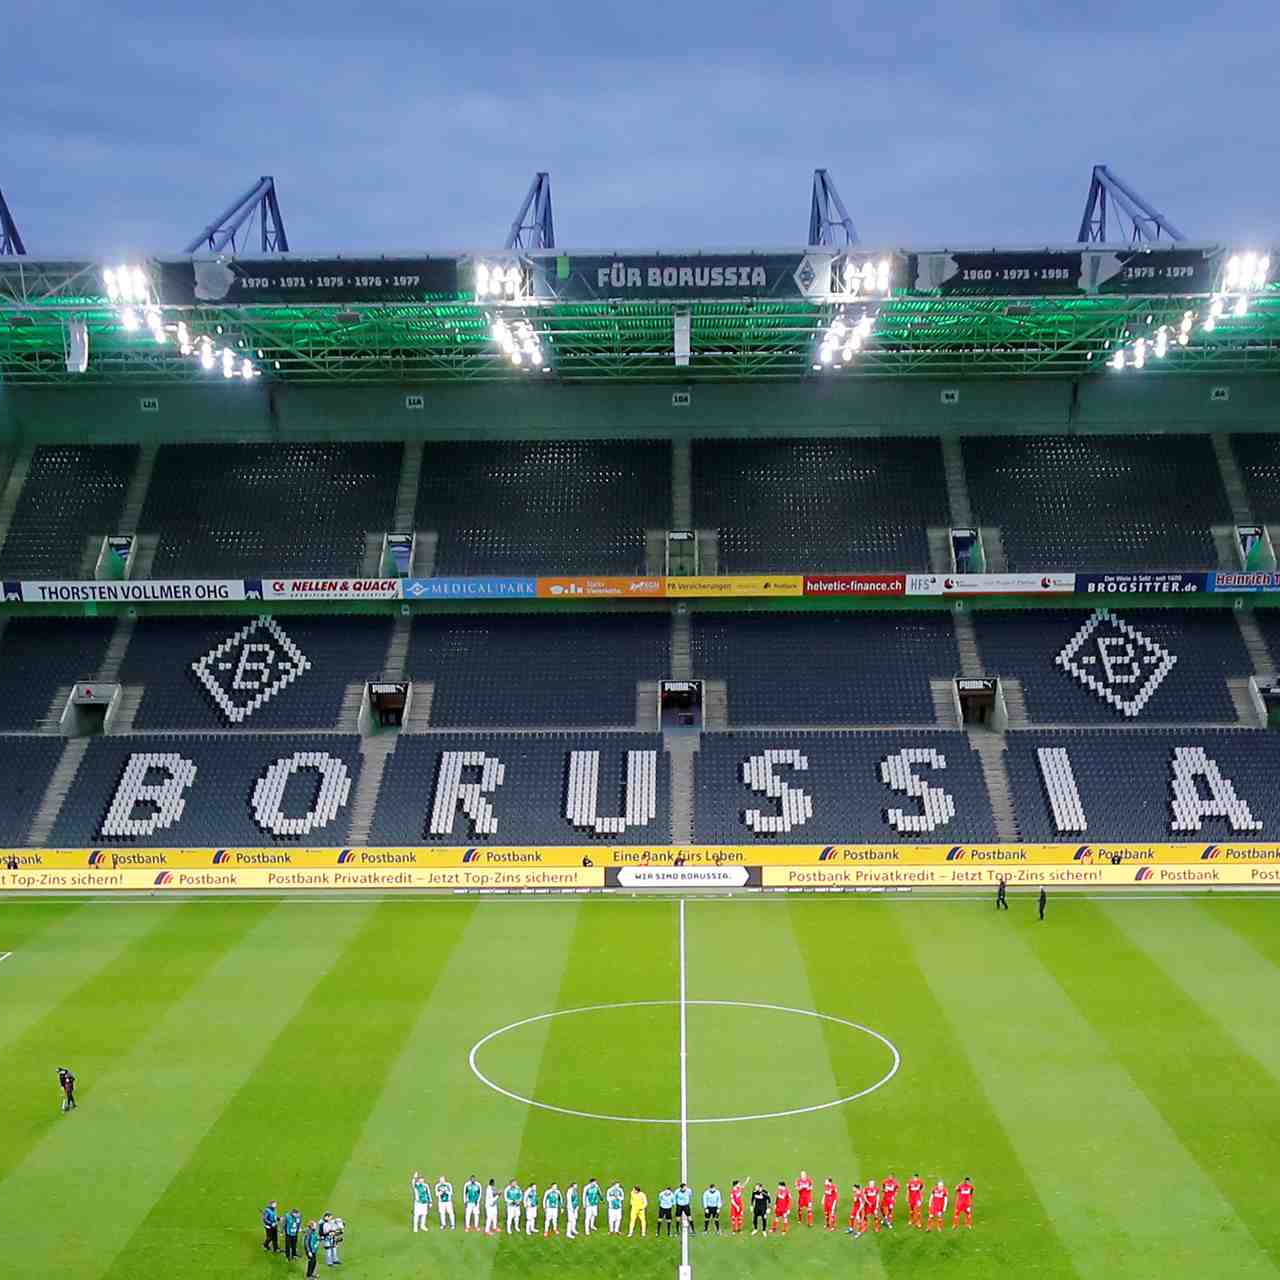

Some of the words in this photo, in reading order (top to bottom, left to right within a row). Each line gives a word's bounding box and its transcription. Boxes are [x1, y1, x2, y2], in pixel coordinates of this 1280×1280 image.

[598, 266, 642, 288] FÜR
[648, 267, 767, 287] BORUSSIA
[963, 269, 992, 280] 1960
[241, 278, 273, 289] 1970
[280, 278, 307, 288] 1971
[317, 277, 344, 288] 1975
[392, 276, 420, 287] 1977
[292, 581, 338, 592] NELLEN
[340, 581, 350, 592] &
[353, 581, 397, 592] QUACK
[432, 583, 492, 594] MEDICAL
[496, 582, 535, 593] PARK
[806, 576, 903, 592] helvetic-finance.ch
[1087, 582, 1198, 592] BROGSITTER.de
[39, 585, 118, 601] THORSTEN
[121, 585, 192, 600] VOLLMER
[196, 584, 229, 600] OHG
[100, 747, 1263, 837] BORUSSIA
[236, 852, 292, 865] Postbank
[361, 851, 417, 864] Postbank
[487, 851, 542, 864] Postbank
[613, 850, 640, 862] Eine
[843, 850, 899, 862] Postbank
[971, 849, 1026, 862] Postbank
[1225, 847, 1280, 860] Postbank
[11, 873, 67, 888] Top-Zins
[70, 873, 123, 886] sichern!
[179, 872, 238, 885] Postbank
[268, 872, 330, 885] Postbank
[334, 871, 413, 885] Privatkredit
[425, 871, 460, 885] Jetzt
[463, 871, 521, 886] Top-Zins
[525, 870, 579, 884] sichern!
[635, 873, 653, 881] WIR
[788, 870, 850, 884] Postbank
[856, 869, 935, 883] Privatkredit
[951, 869, 985, 883] Jetzt
[986, 869, 1045, 885] Top-Zins
[1048, 868, 1103, 882] sichern!
[1161, 867, 1220, 881] Postbank
